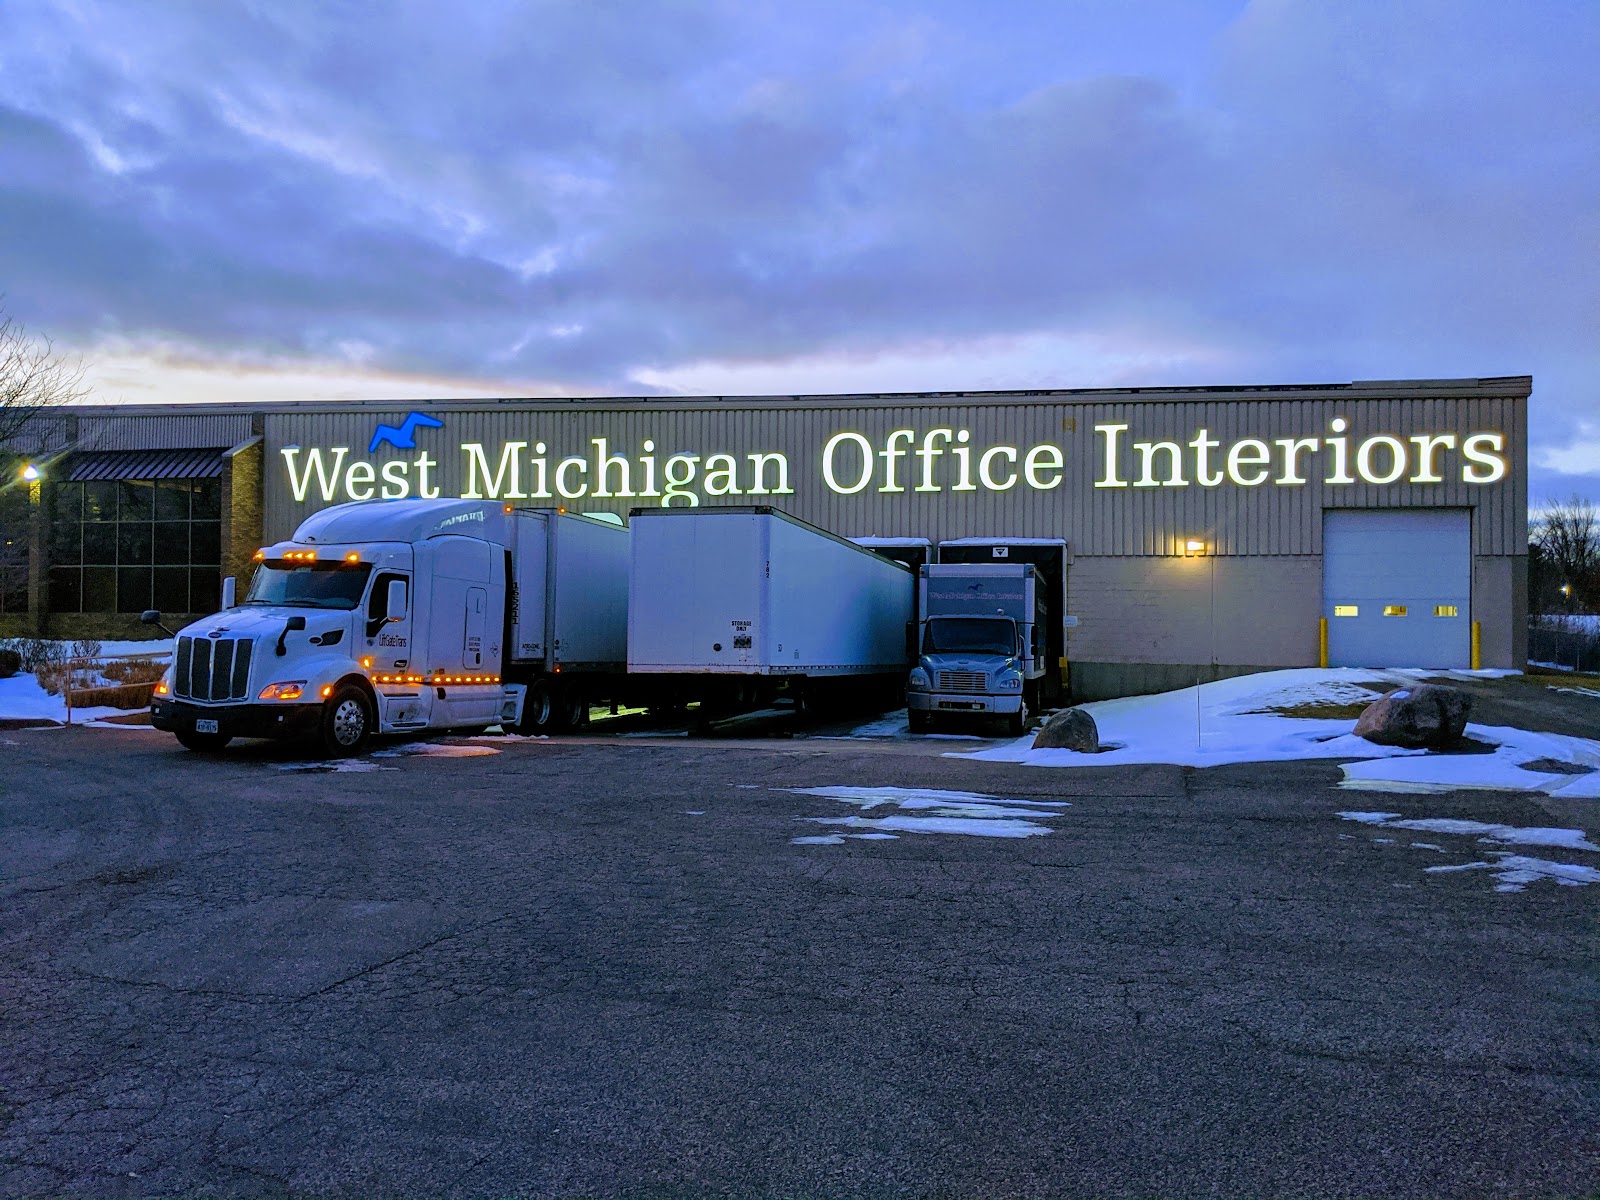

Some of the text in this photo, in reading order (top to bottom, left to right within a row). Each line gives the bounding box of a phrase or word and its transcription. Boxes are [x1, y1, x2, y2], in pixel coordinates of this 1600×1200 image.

[280, 418, 1505, 508] West Michigan Office Interiors
